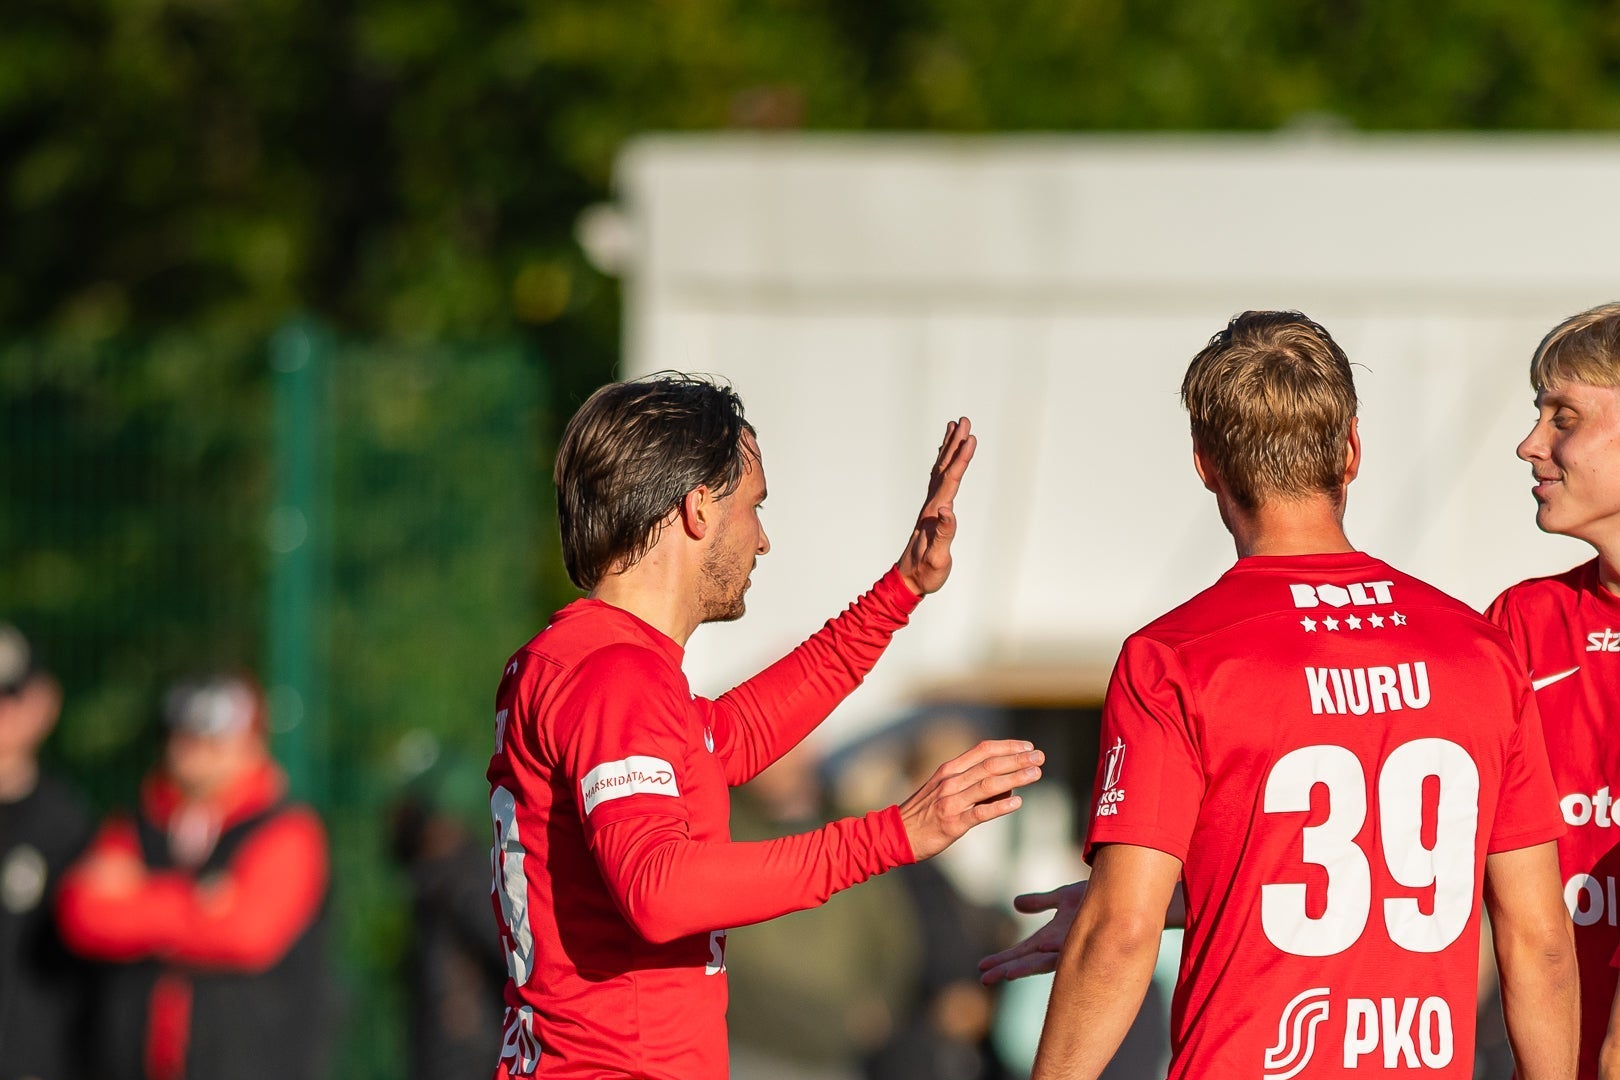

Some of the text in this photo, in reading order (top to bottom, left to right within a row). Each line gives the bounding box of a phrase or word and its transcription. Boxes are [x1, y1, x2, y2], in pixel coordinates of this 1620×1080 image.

[1289, 580, 1395, 609] BOLT
[1305, 661, 1431, 715] KIURU
[584, 770, 645, 802] MARSKIDATA
[1098, 788, 1125, 805] KÖS
[1095, 803, 1118, 819] IGA
[1261, 737, 1480, 957] 39
[1342, 996, 1454, 1071] PKO
